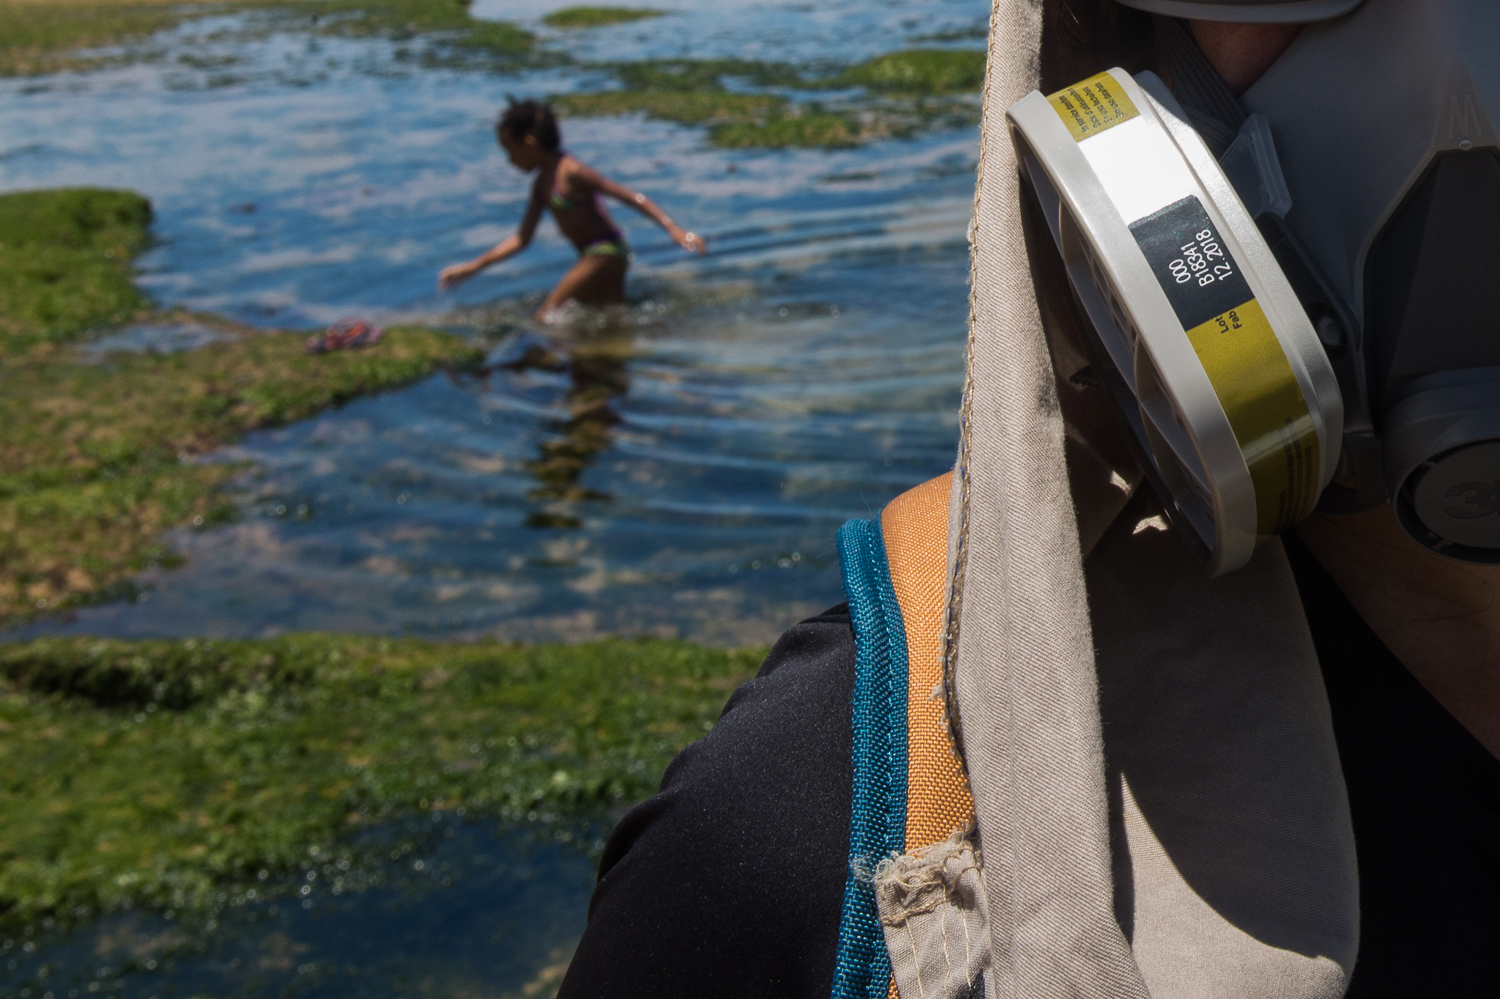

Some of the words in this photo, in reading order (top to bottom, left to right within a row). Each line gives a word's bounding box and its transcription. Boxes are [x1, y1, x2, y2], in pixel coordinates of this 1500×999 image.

[1169, 259, 1191, 283] 000
[1181, 242, 1215, 286] B18341
[1215, 316, 1229, 334] Lot
[1229, 311, 1242, 329] Fab
